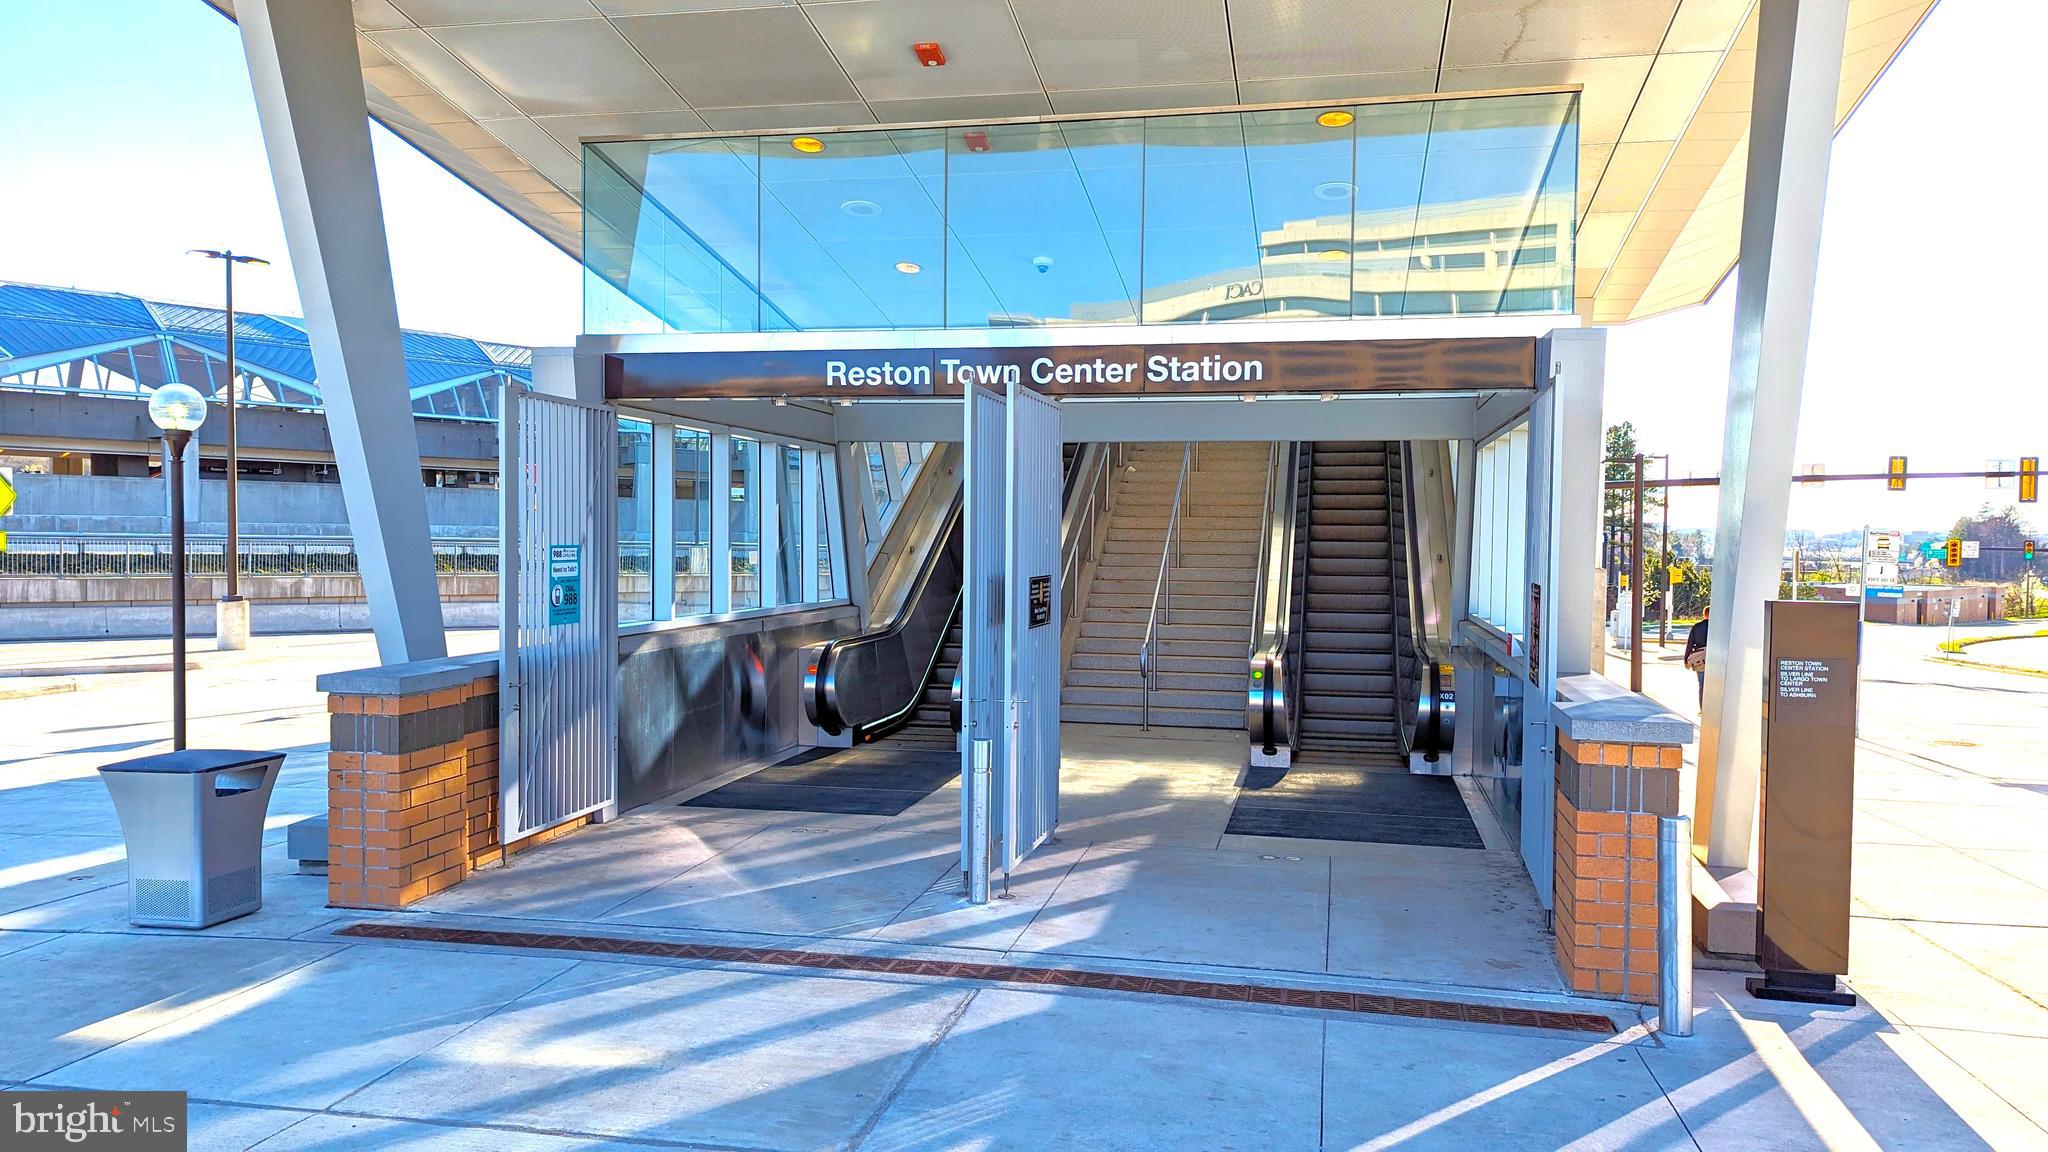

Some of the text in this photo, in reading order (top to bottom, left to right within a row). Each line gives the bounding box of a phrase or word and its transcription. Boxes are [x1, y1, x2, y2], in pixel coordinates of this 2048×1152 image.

[826, 355, 1263, 386] Reston Town Center Station
[553, 550, 562, 558] 988
[564, 593, 577, 605] 988
